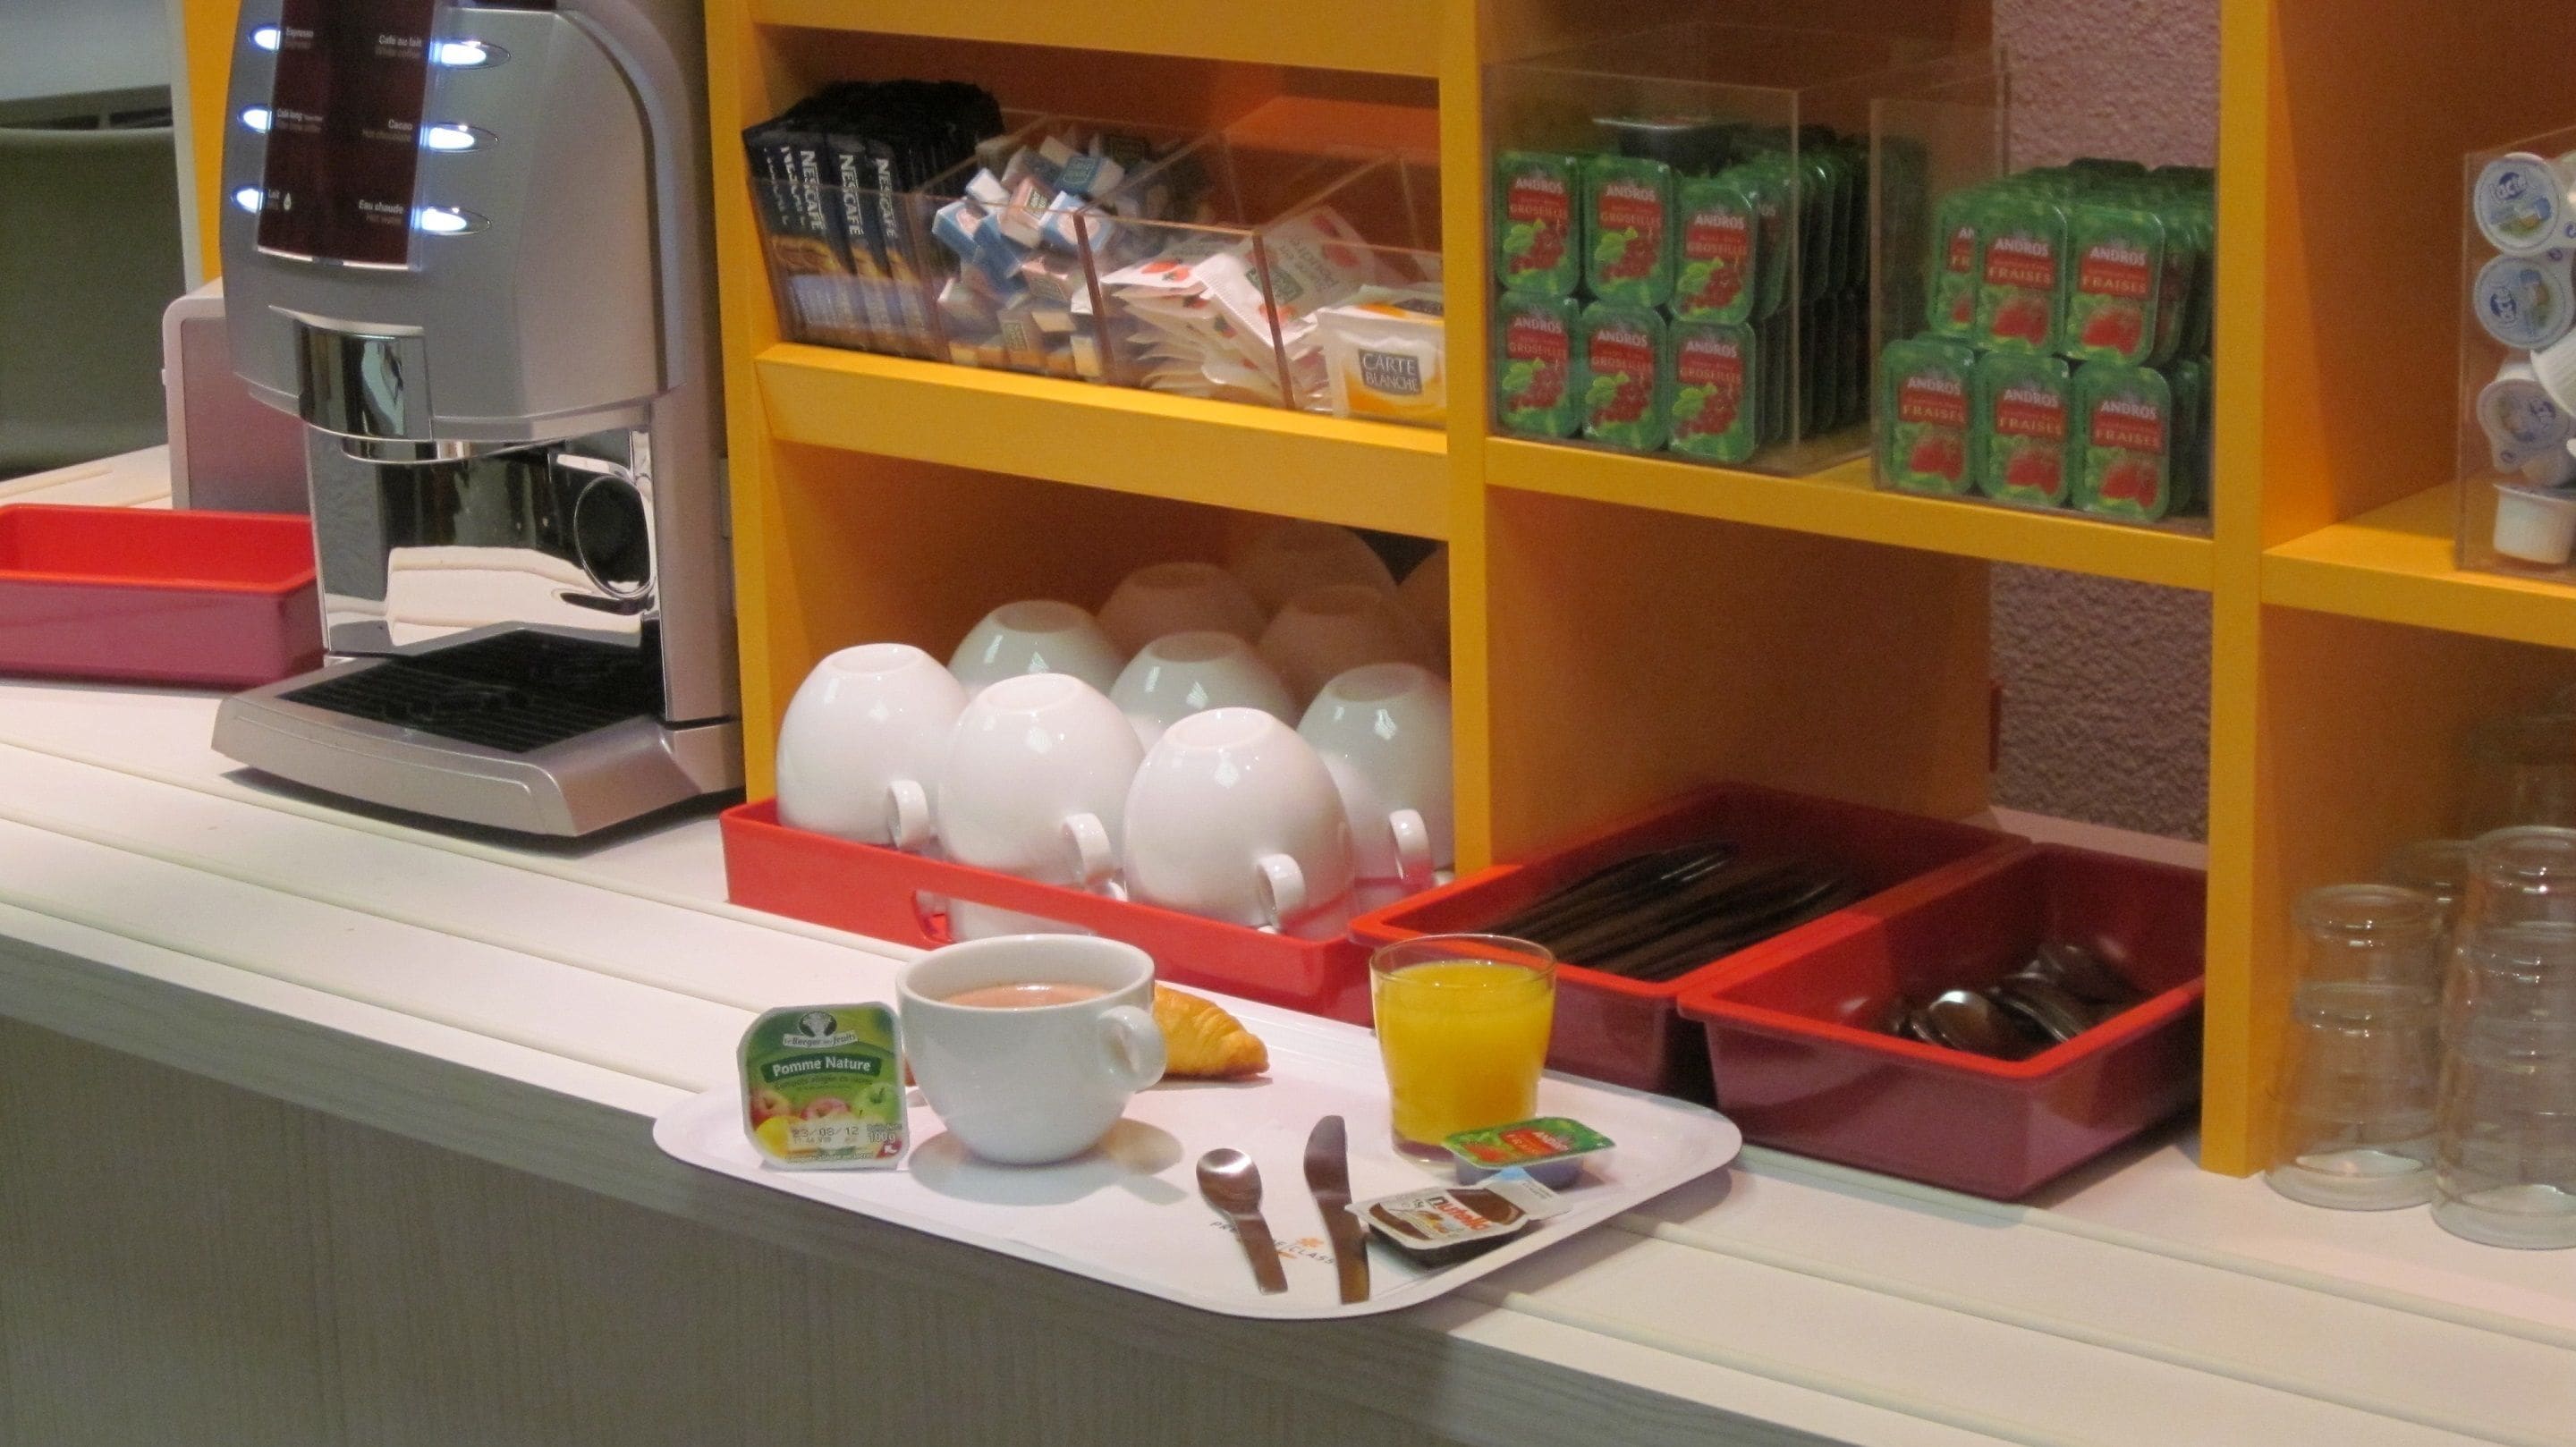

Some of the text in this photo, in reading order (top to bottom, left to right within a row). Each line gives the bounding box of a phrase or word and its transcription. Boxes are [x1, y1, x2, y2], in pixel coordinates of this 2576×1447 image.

[388, 119, 412, 130] Cacao
[1515, 177, 1563, 194] ANDROS
[1606, 185, 1656, 202] ANDROS
[359, 199, 403, 214] Eau chaude
[1694, 214, 1745, 230] ANDROS
[1994, 238, 2049, 258] ANDROS
[2089, 246, 2146, 267] ANDROS
[1987, 266, 2052, 285] FRAISES
[2081, 275, 2147, 294] FRAISES
[1513, 317, 1562, 334] ANDROS
[1597, 330, 1648, 347] ANDROS
[1686, 340, 1736, 358] ANDROS
[1363, 353, 1416, 376] CARTE
[1366, 371, 1419, 393] BLANCHE
[1907, 377, 1962, 395] ANDROS
[2004, 388, 2059, 408] ANDROS
[1902, 404, 1965, 424] FRAISES
[2101, 400, 2157, 419] ANDROS
[1999, 416, 2063, 436] FRAISES
[792, 1037, 820, 1046] Berger
[772, 1056, 871, 1077] Pomme Nature
[1428, 1195, 1492, 1231] nutella
[1289, 1244, 1335, 1265] CLASS
